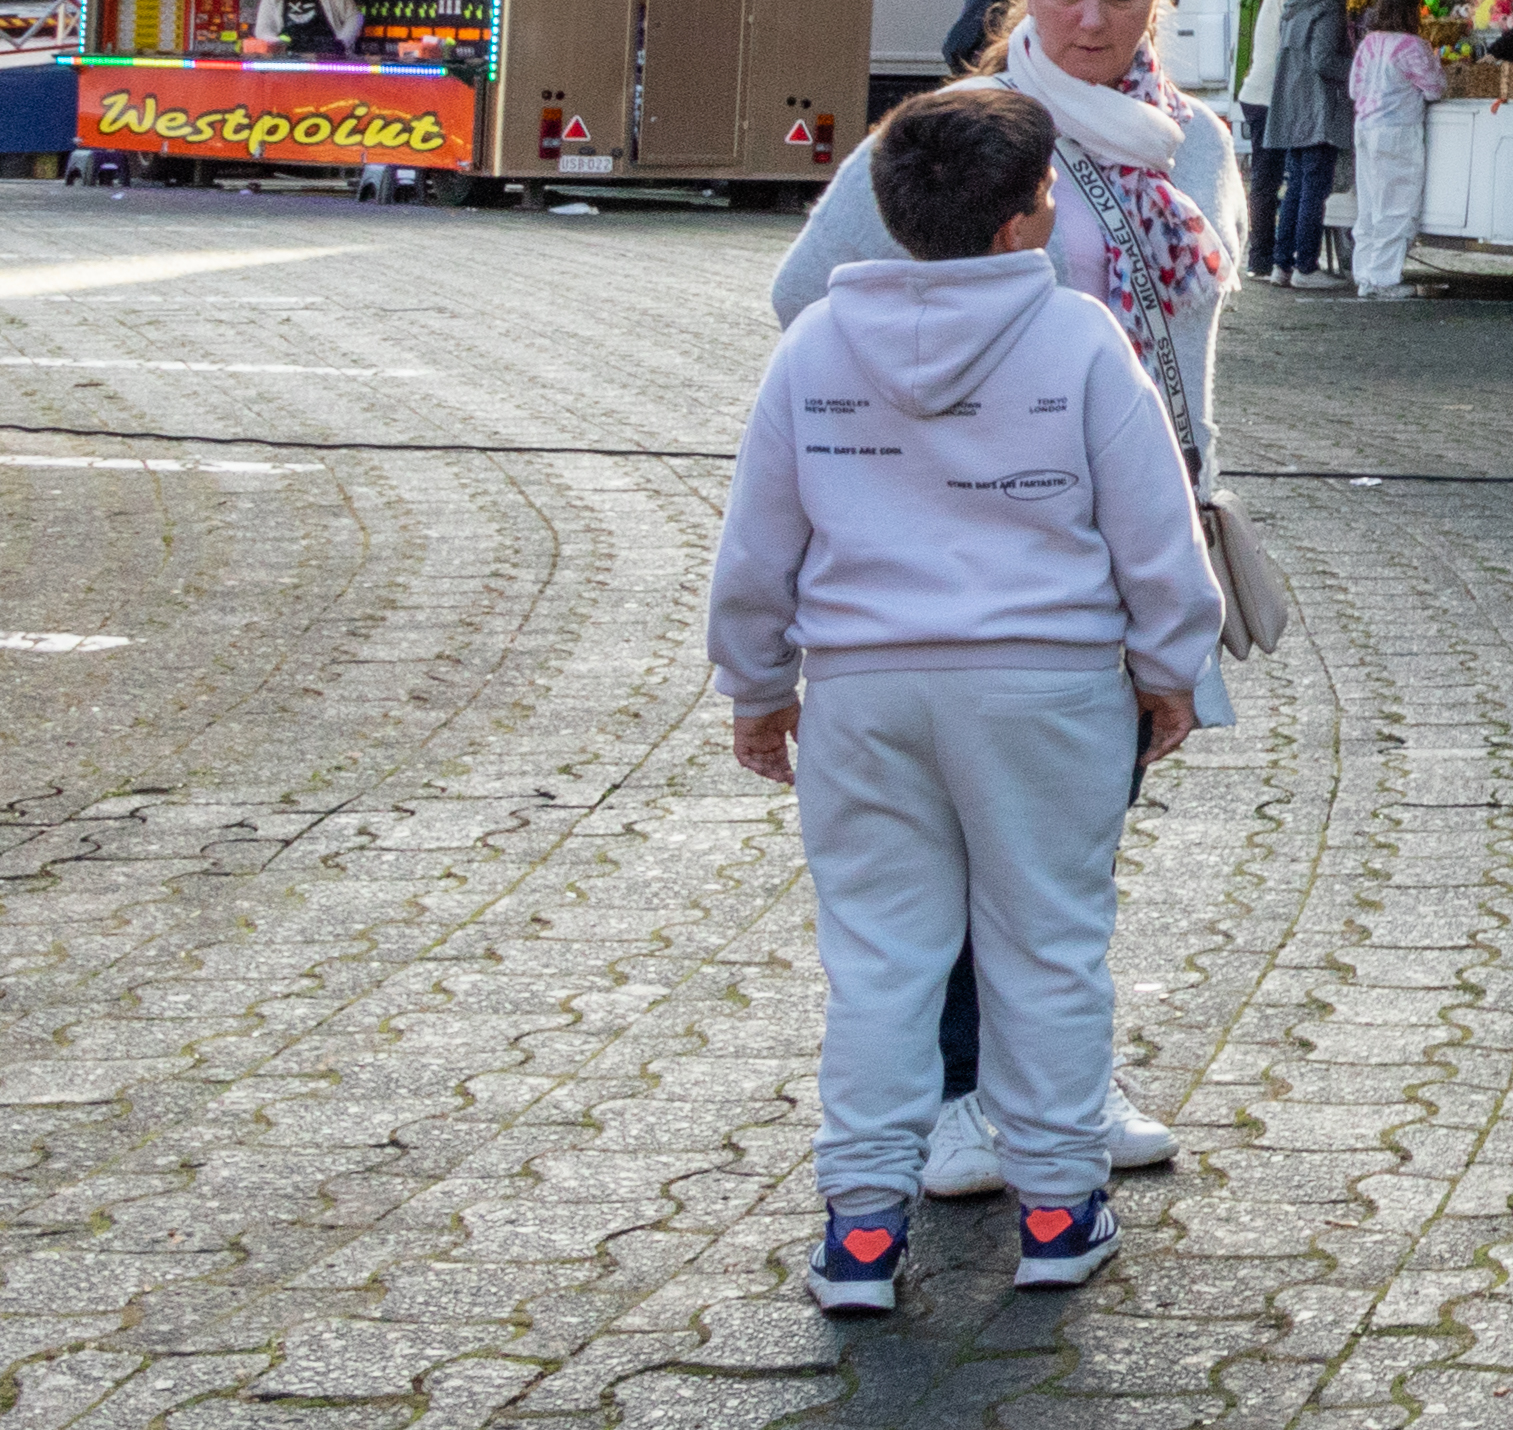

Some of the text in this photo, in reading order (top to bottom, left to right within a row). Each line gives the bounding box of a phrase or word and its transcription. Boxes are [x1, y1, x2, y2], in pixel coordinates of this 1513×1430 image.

[98, 88, 446, 154] Westpoint
[1073, 159, 1115, 213] KORS
[1158, 336, 1182, 397] KORS
